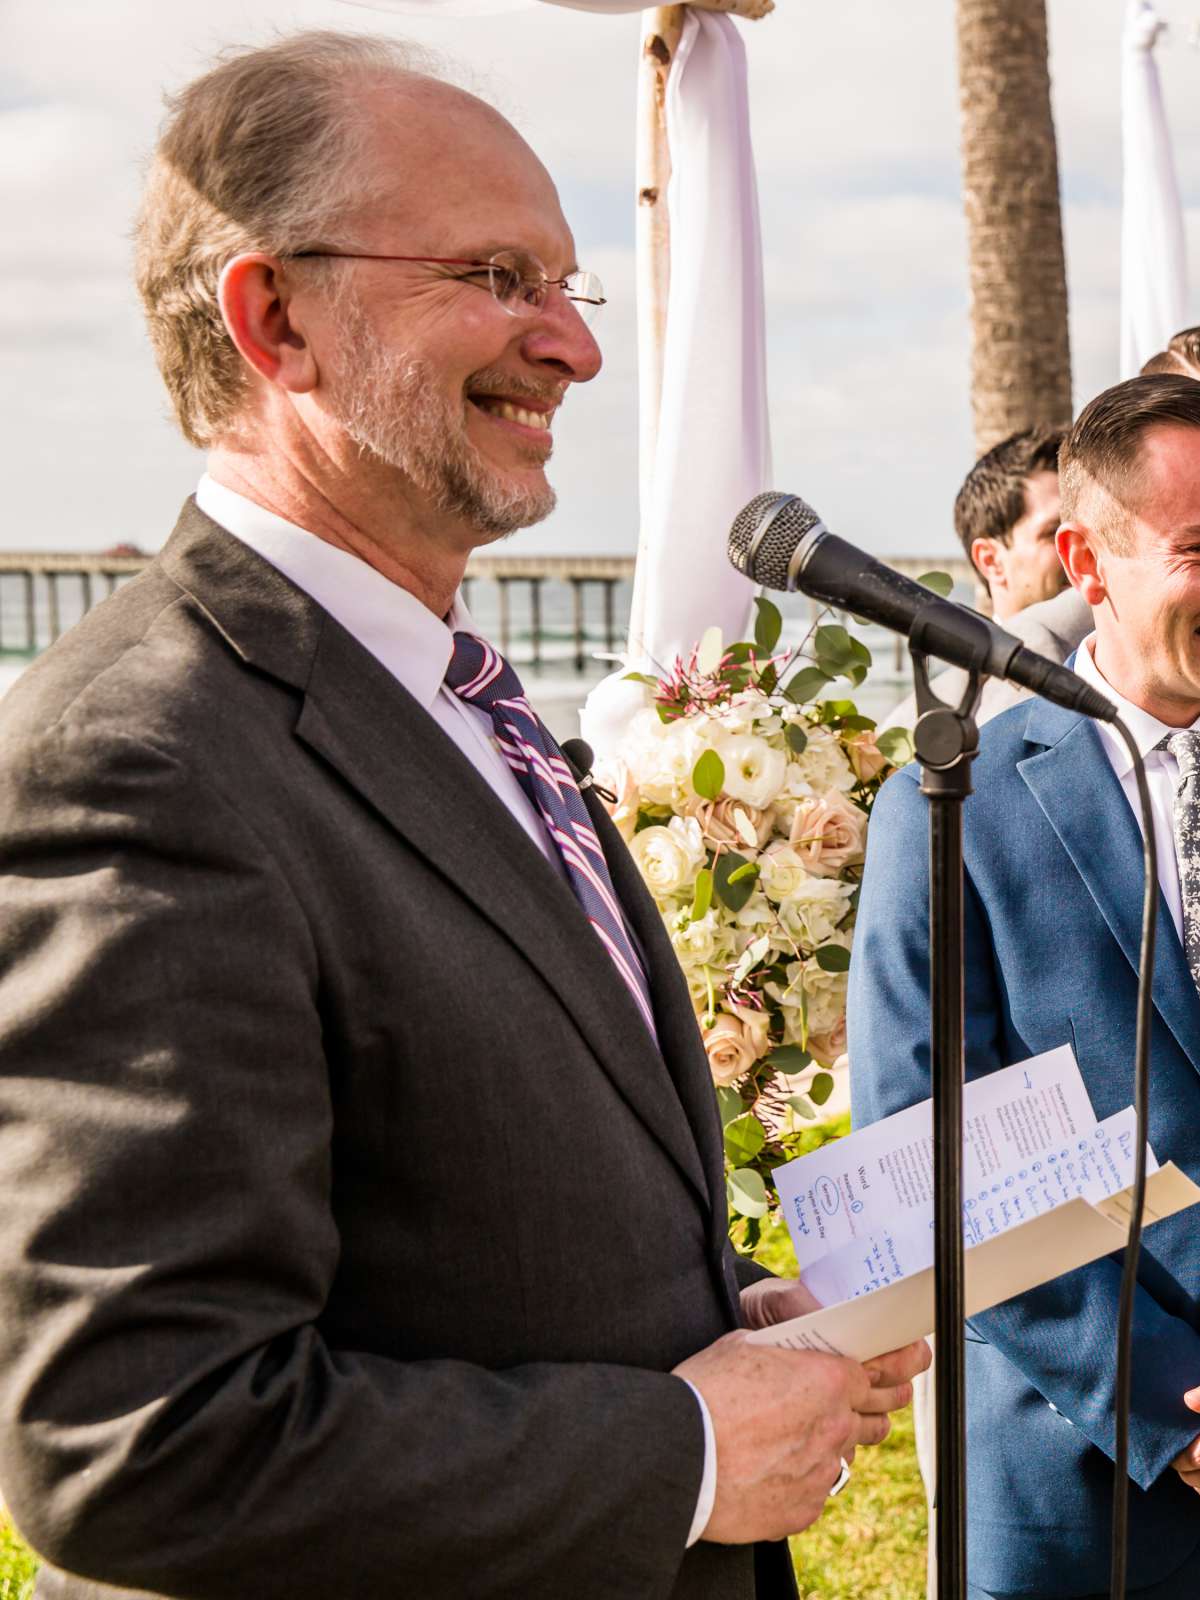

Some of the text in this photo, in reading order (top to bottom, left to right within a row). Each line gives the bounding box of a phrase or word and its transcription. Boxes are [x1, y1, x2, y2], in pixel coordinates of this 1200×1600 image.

[842, 1173, 855, 1201] Readings
[856, 1165, 870, 1190] Word
[821, 1183, 833, 1207] Sermon
[817, 1226, 826, 1238] Day
